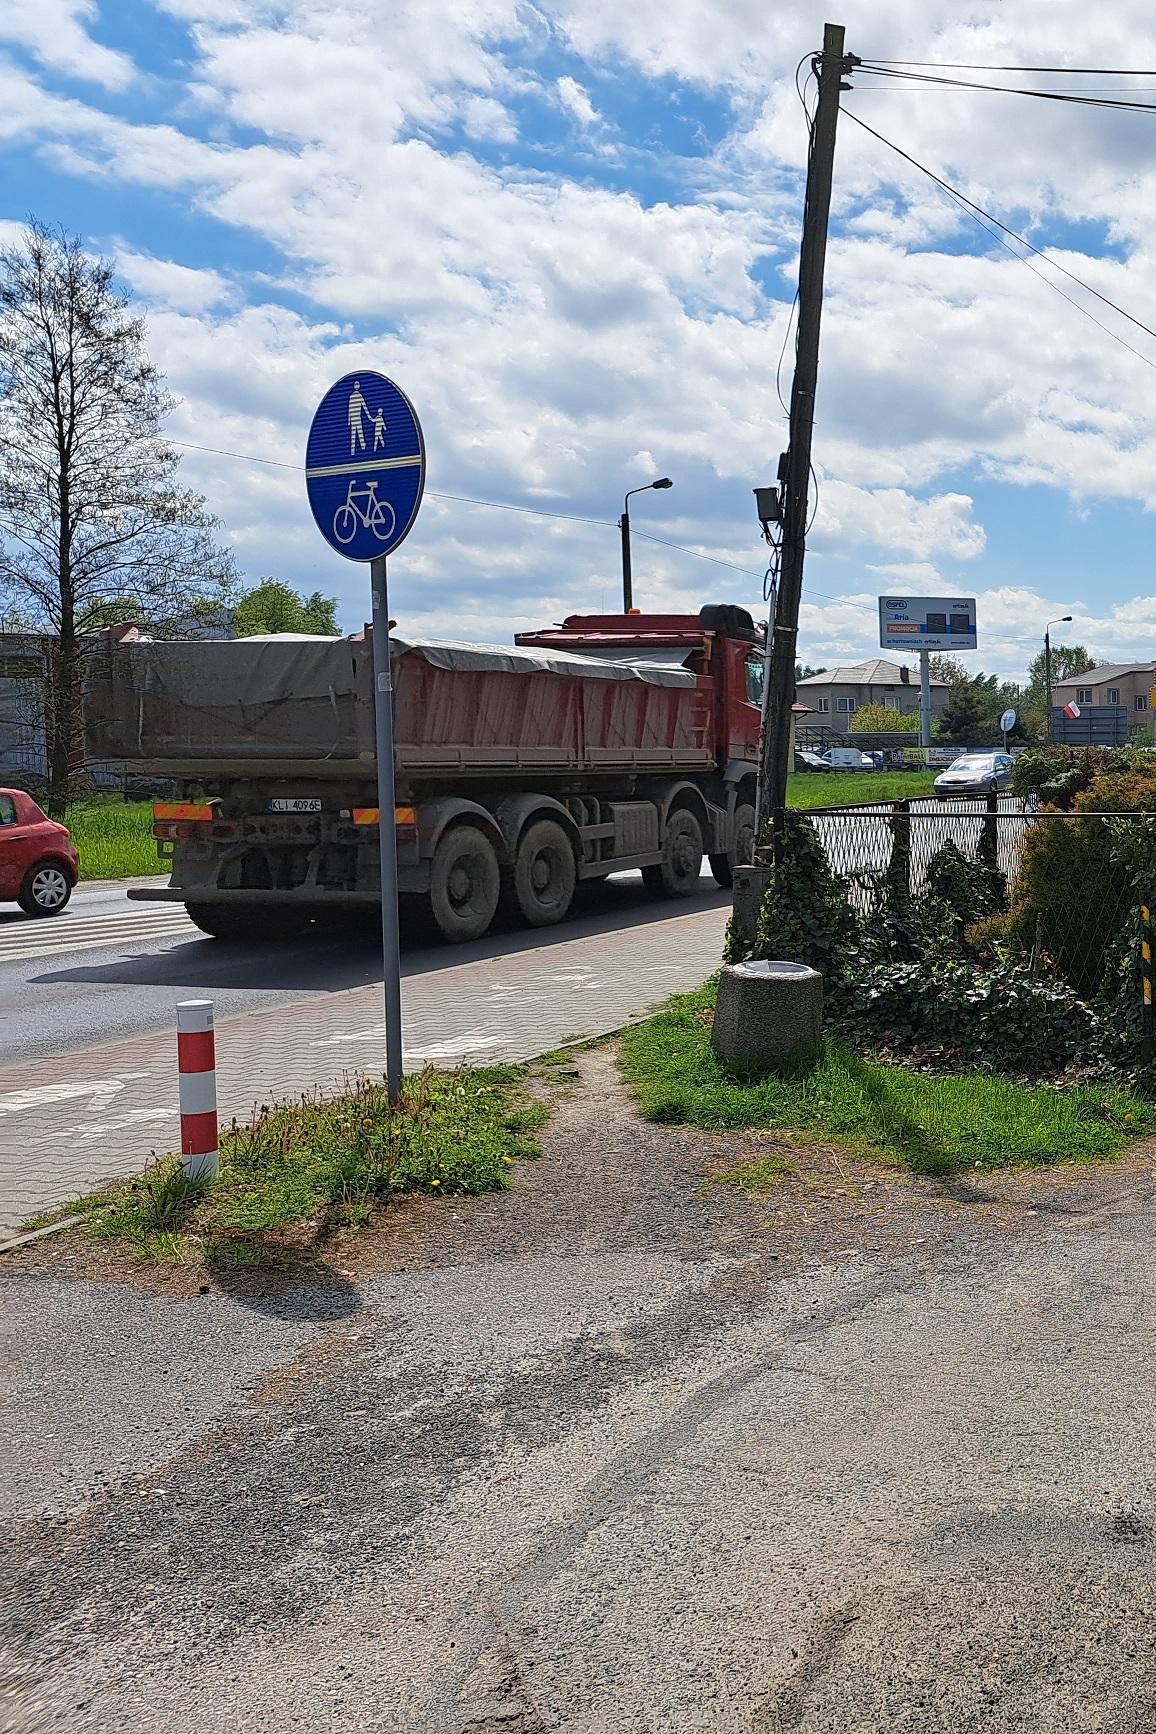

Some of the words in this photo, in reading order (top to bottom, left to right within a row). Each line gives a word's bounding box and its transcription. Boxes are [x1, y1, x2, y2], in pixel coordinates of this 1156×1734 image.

[894, 613, 909, 621] Aria
[272, 799, 289, 811] KLI
[292, 799, 321, 811] 4096E
